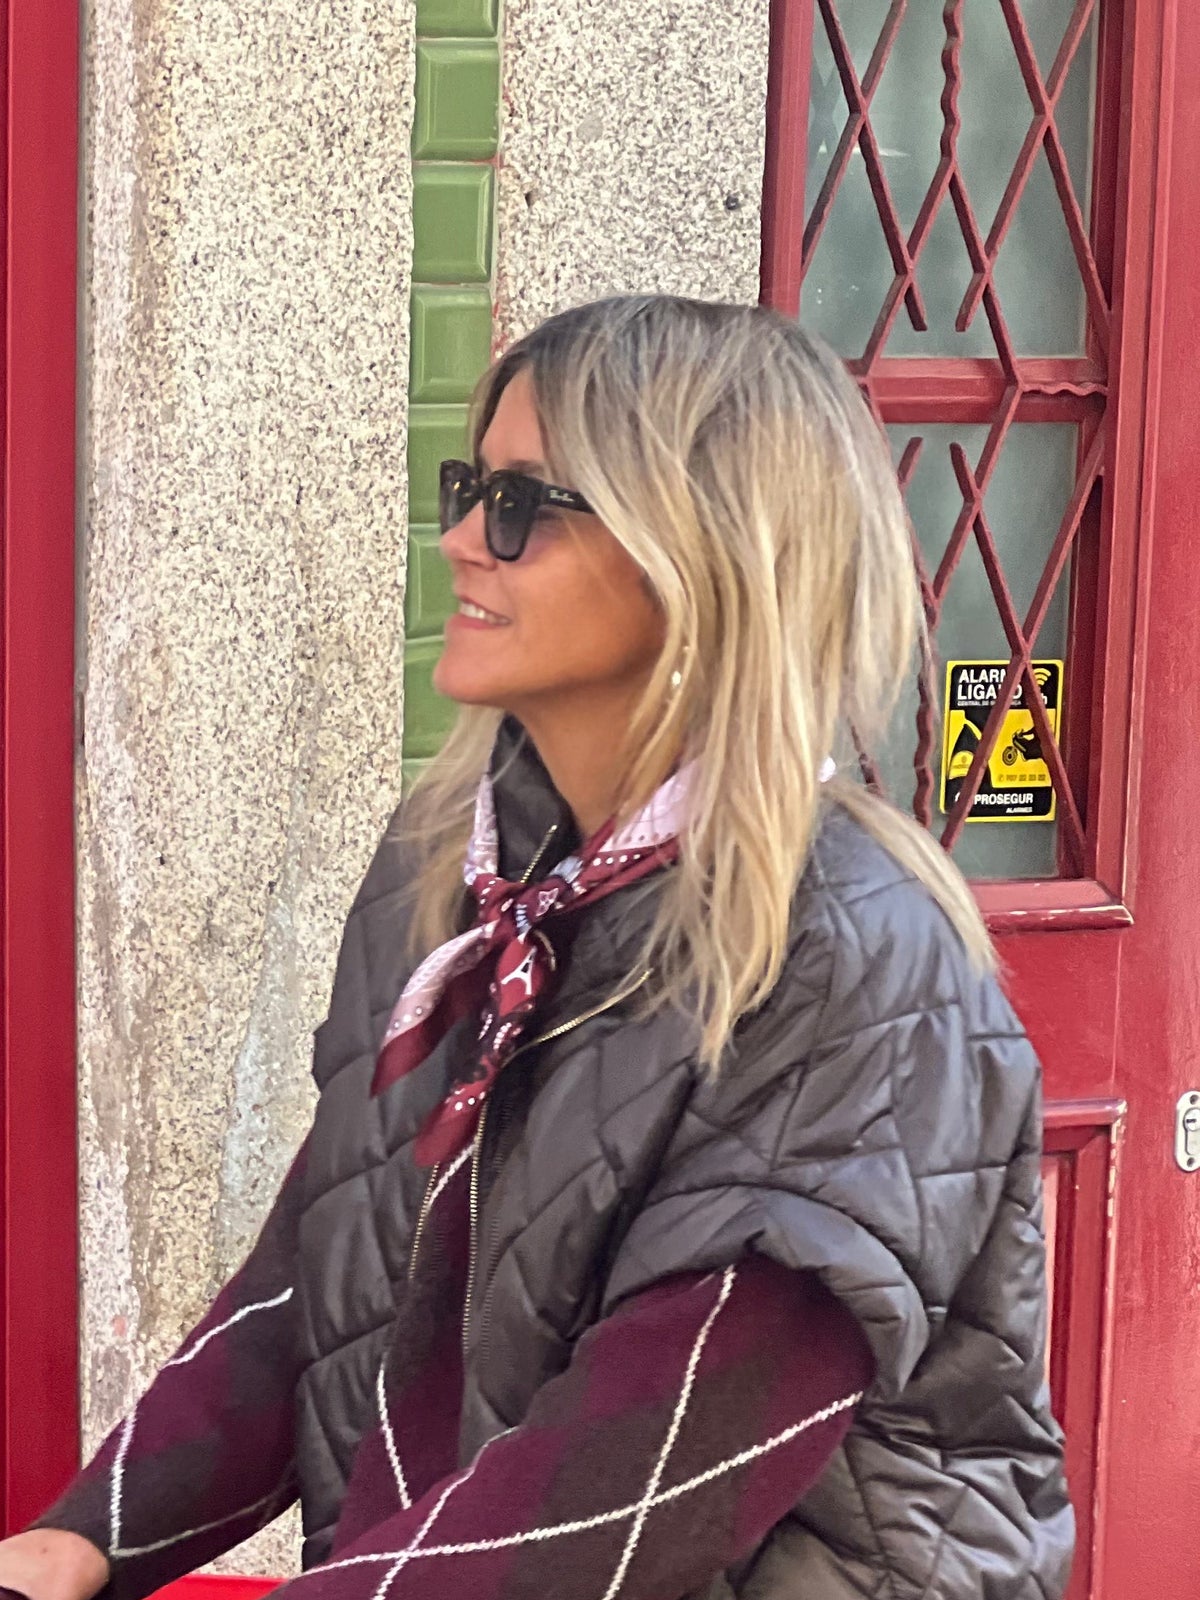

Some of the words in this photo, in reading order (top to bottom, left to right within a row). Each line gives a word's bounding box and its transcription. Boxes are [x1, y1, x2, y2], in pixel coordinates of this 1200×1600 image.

[958, 669, 1006, 683] ALAR
[957, 684, 1023, 700] LIGAO
[974, 793, 1034, 805] PROSEGUR
